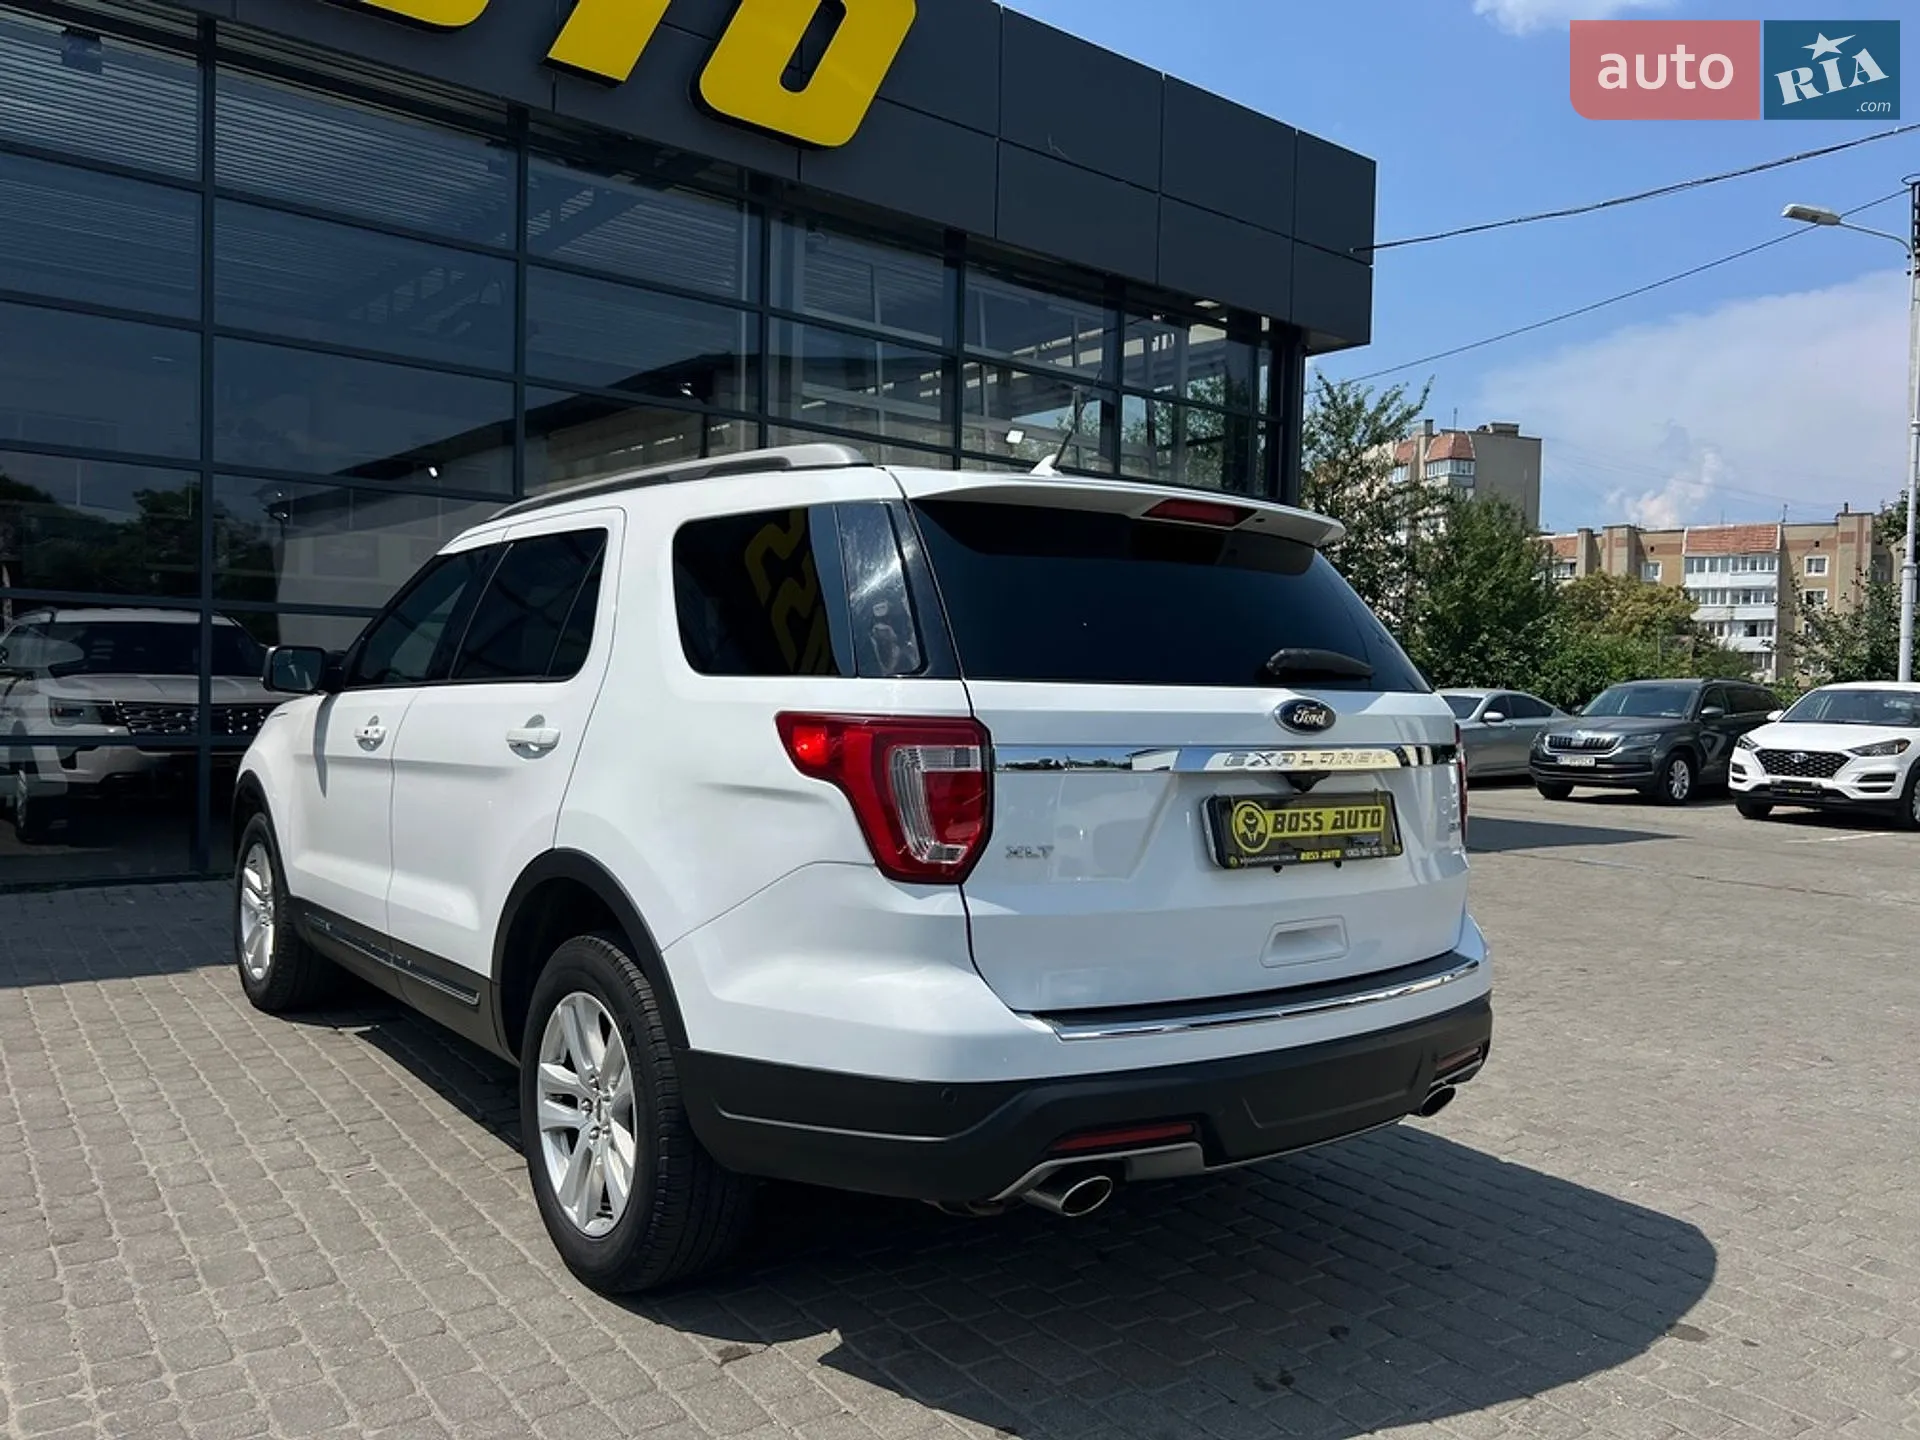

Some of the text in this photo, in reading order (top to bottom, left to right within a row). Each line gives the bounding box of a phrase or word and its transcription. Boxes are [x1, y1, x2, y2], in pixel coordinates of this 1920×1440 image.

[1292, 704, 1328, 727] Ford
[1223, 750, 1388, 768] EXPLORER
[1271, 808, 1383, 834] BOSS AUTO
